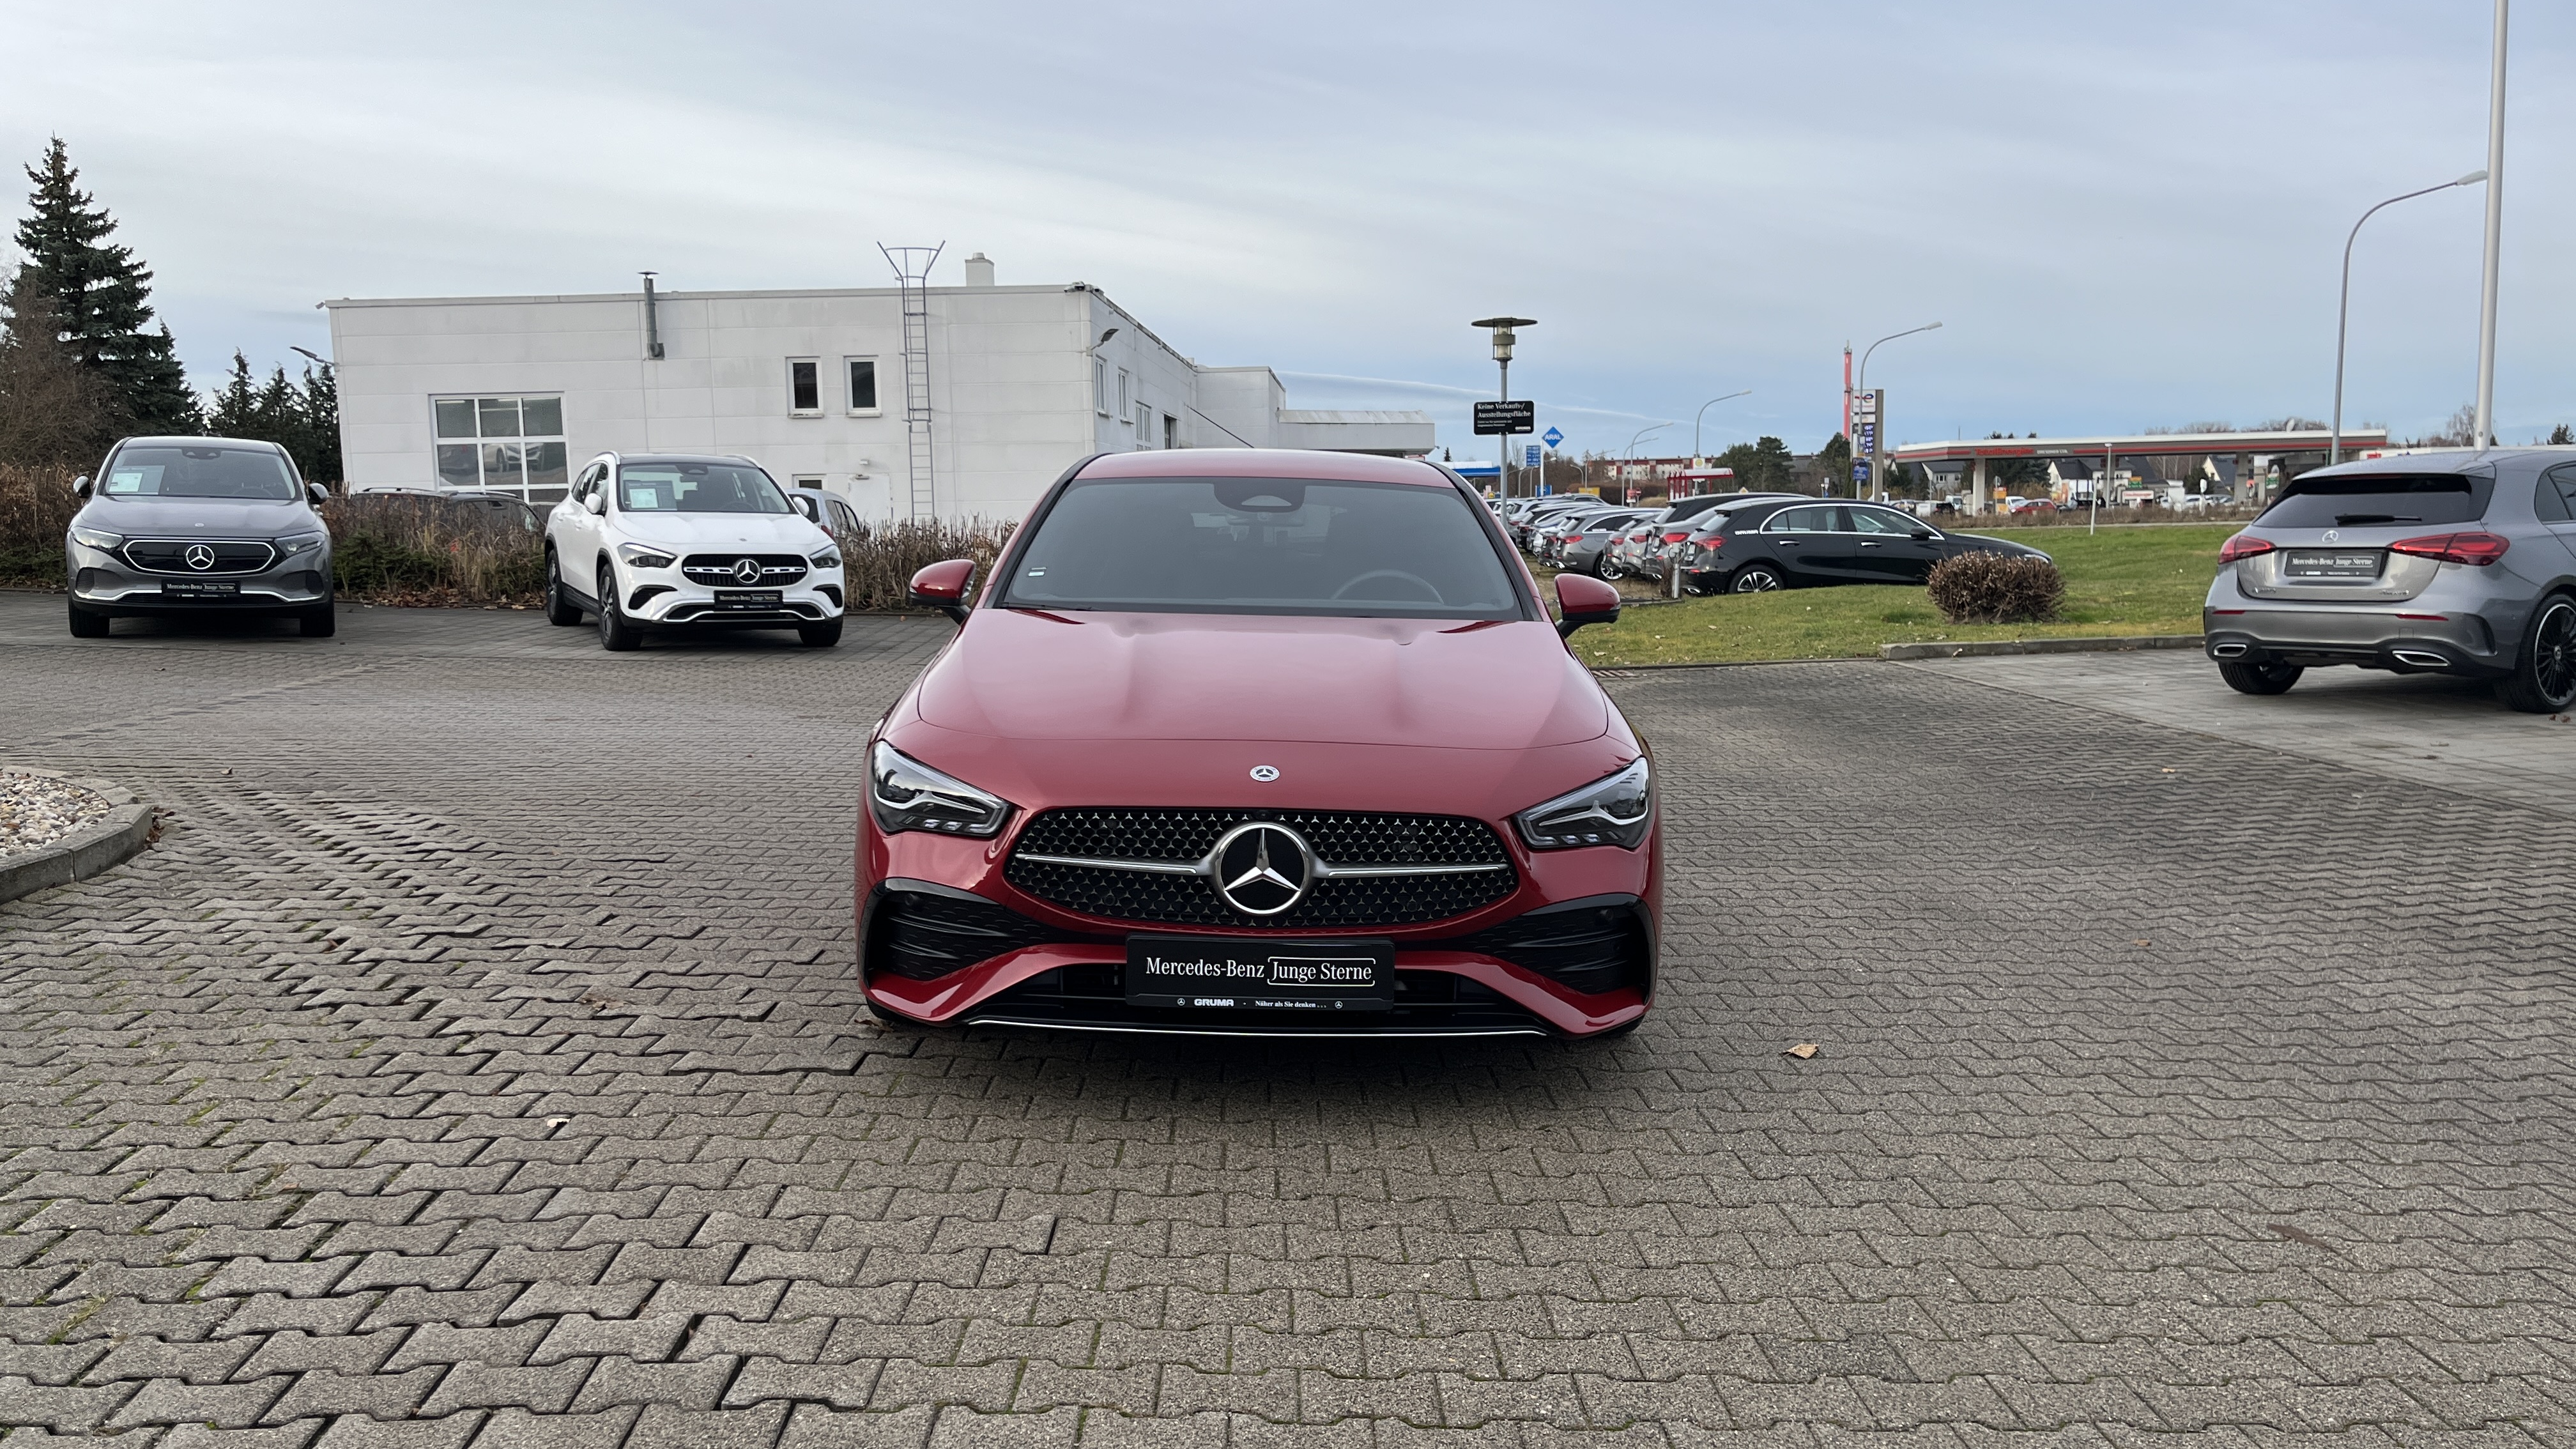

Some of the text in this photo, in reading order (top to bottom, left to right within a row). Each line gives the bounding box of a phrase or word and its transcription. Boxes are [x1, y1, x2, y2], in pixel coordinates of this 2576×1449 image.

[1146, 957, 1372, 983] Mercedes-Benz Junge Sterne
[1194, 998, 1234, 1007] GRUMA
